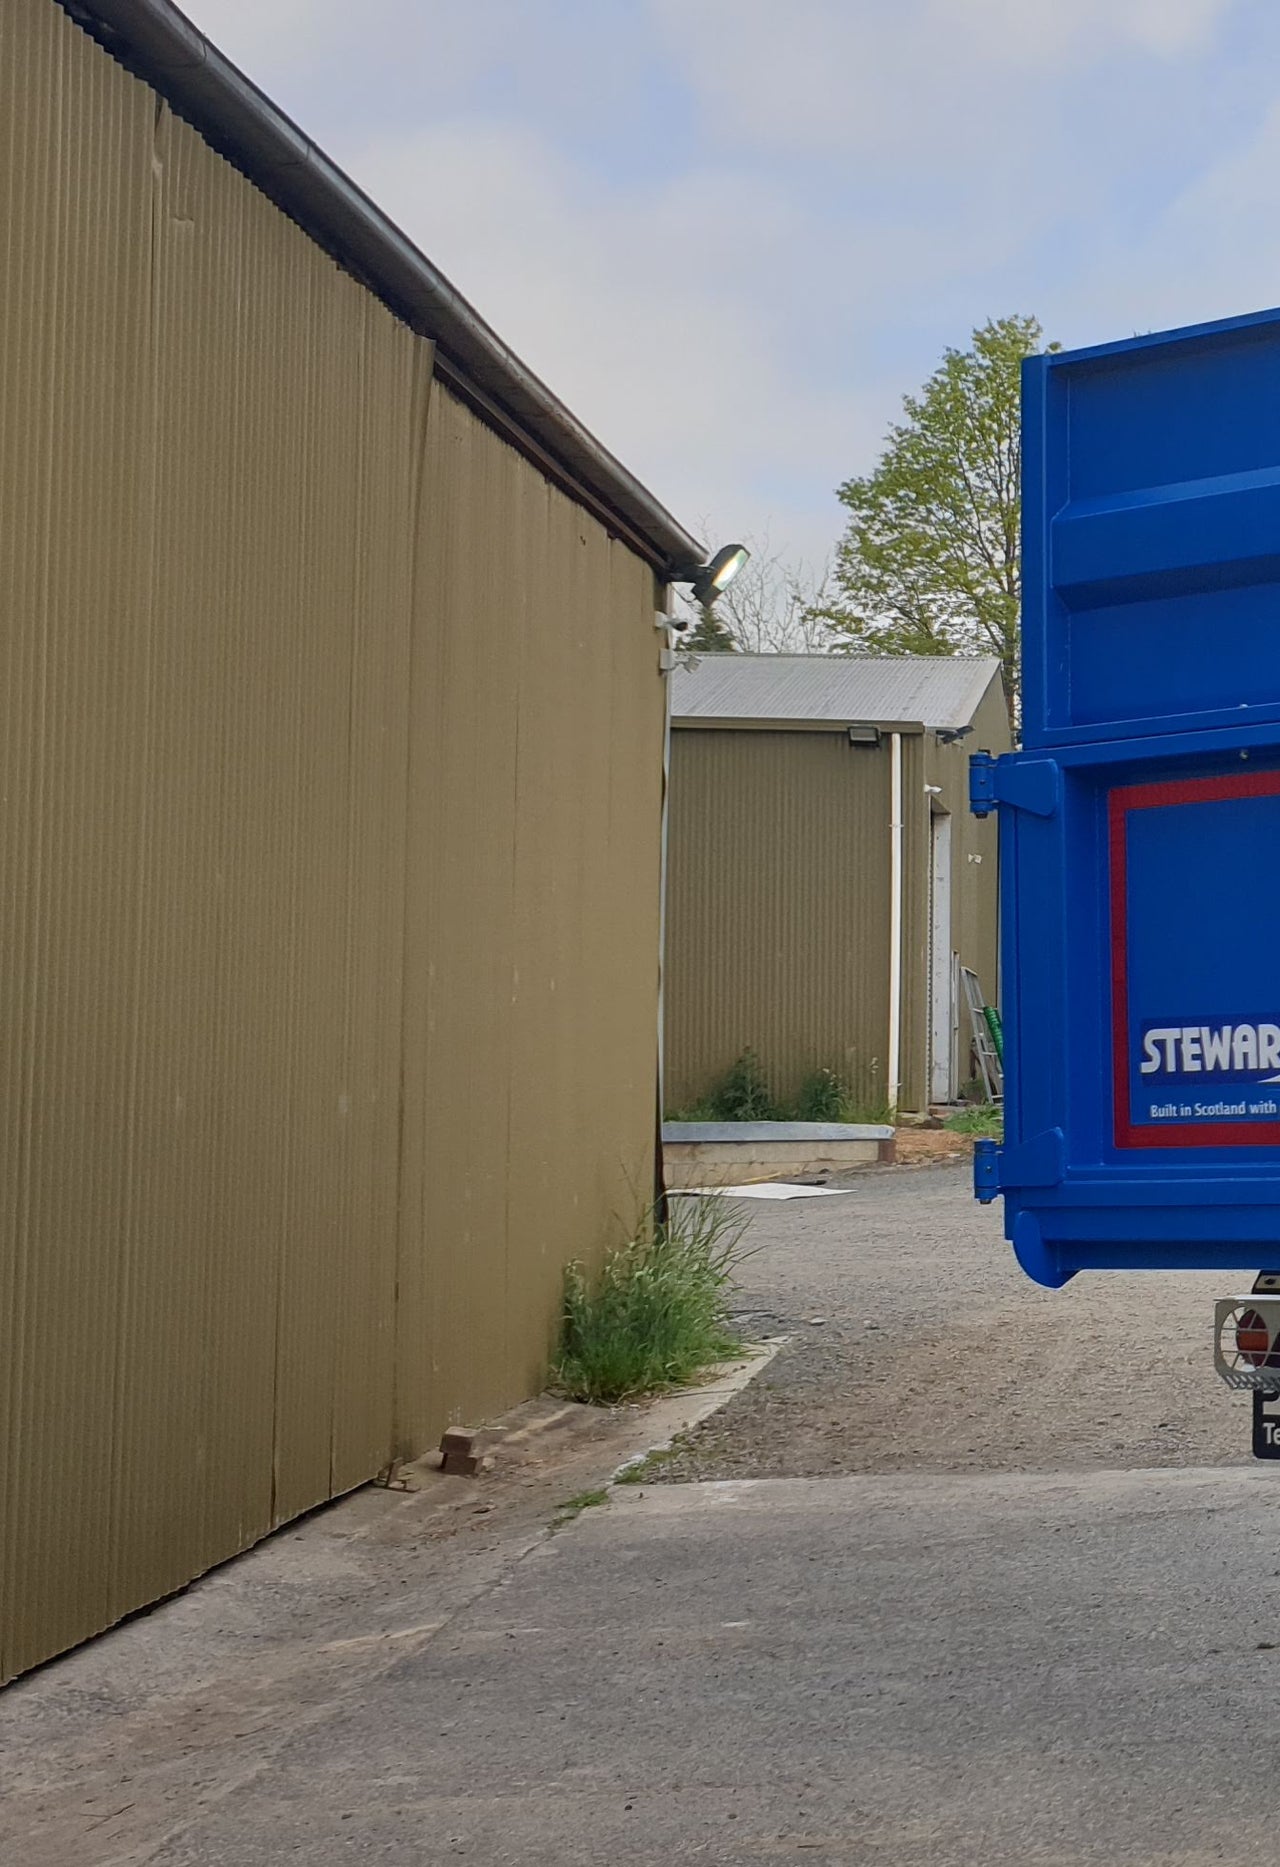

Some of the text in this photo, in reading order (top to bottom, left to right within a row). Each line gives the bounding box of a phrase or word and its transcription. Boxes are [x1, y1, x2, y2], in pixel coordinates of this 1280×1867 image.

[1150, 1103, 1177, 1118] Built
[1180, 1103, 1192, 1117] in
[1194, 1101, 1247, 1117] Scotland
[1249, 1100, 1277, 1115] with
